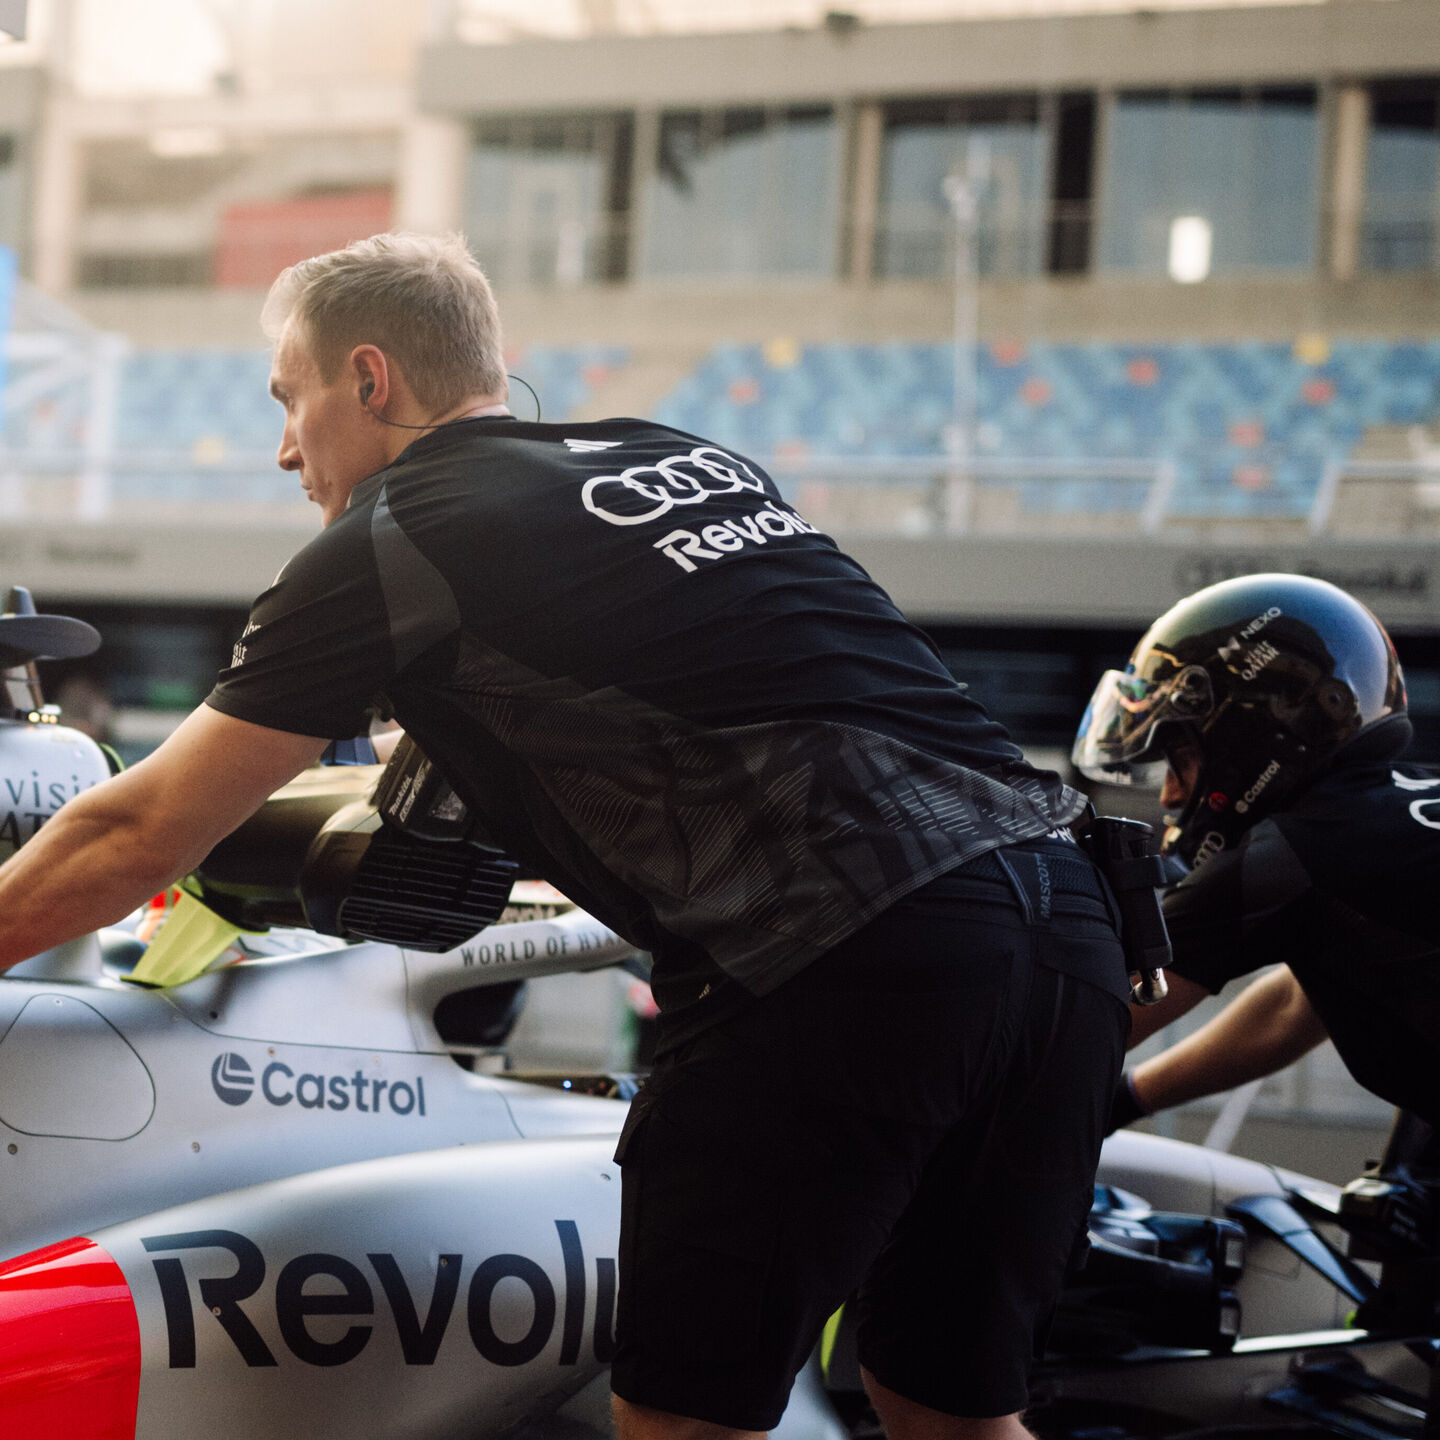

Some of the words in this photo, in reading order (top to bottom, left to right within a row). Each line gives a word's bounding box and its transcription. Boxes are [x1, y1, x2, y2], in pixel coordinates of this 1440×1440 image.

[1240, 606, 1281, 640] NEXO
[4, 770, 97, 811] visi
[1244, 759, 1281, 803] Castrol
[1033, 852, 1052, 920] MASCOT
[460, 939, 536, 968] WORLD
[546, 934, 571, 957] OF
[261, 1061, 426, 1117] Castrol
